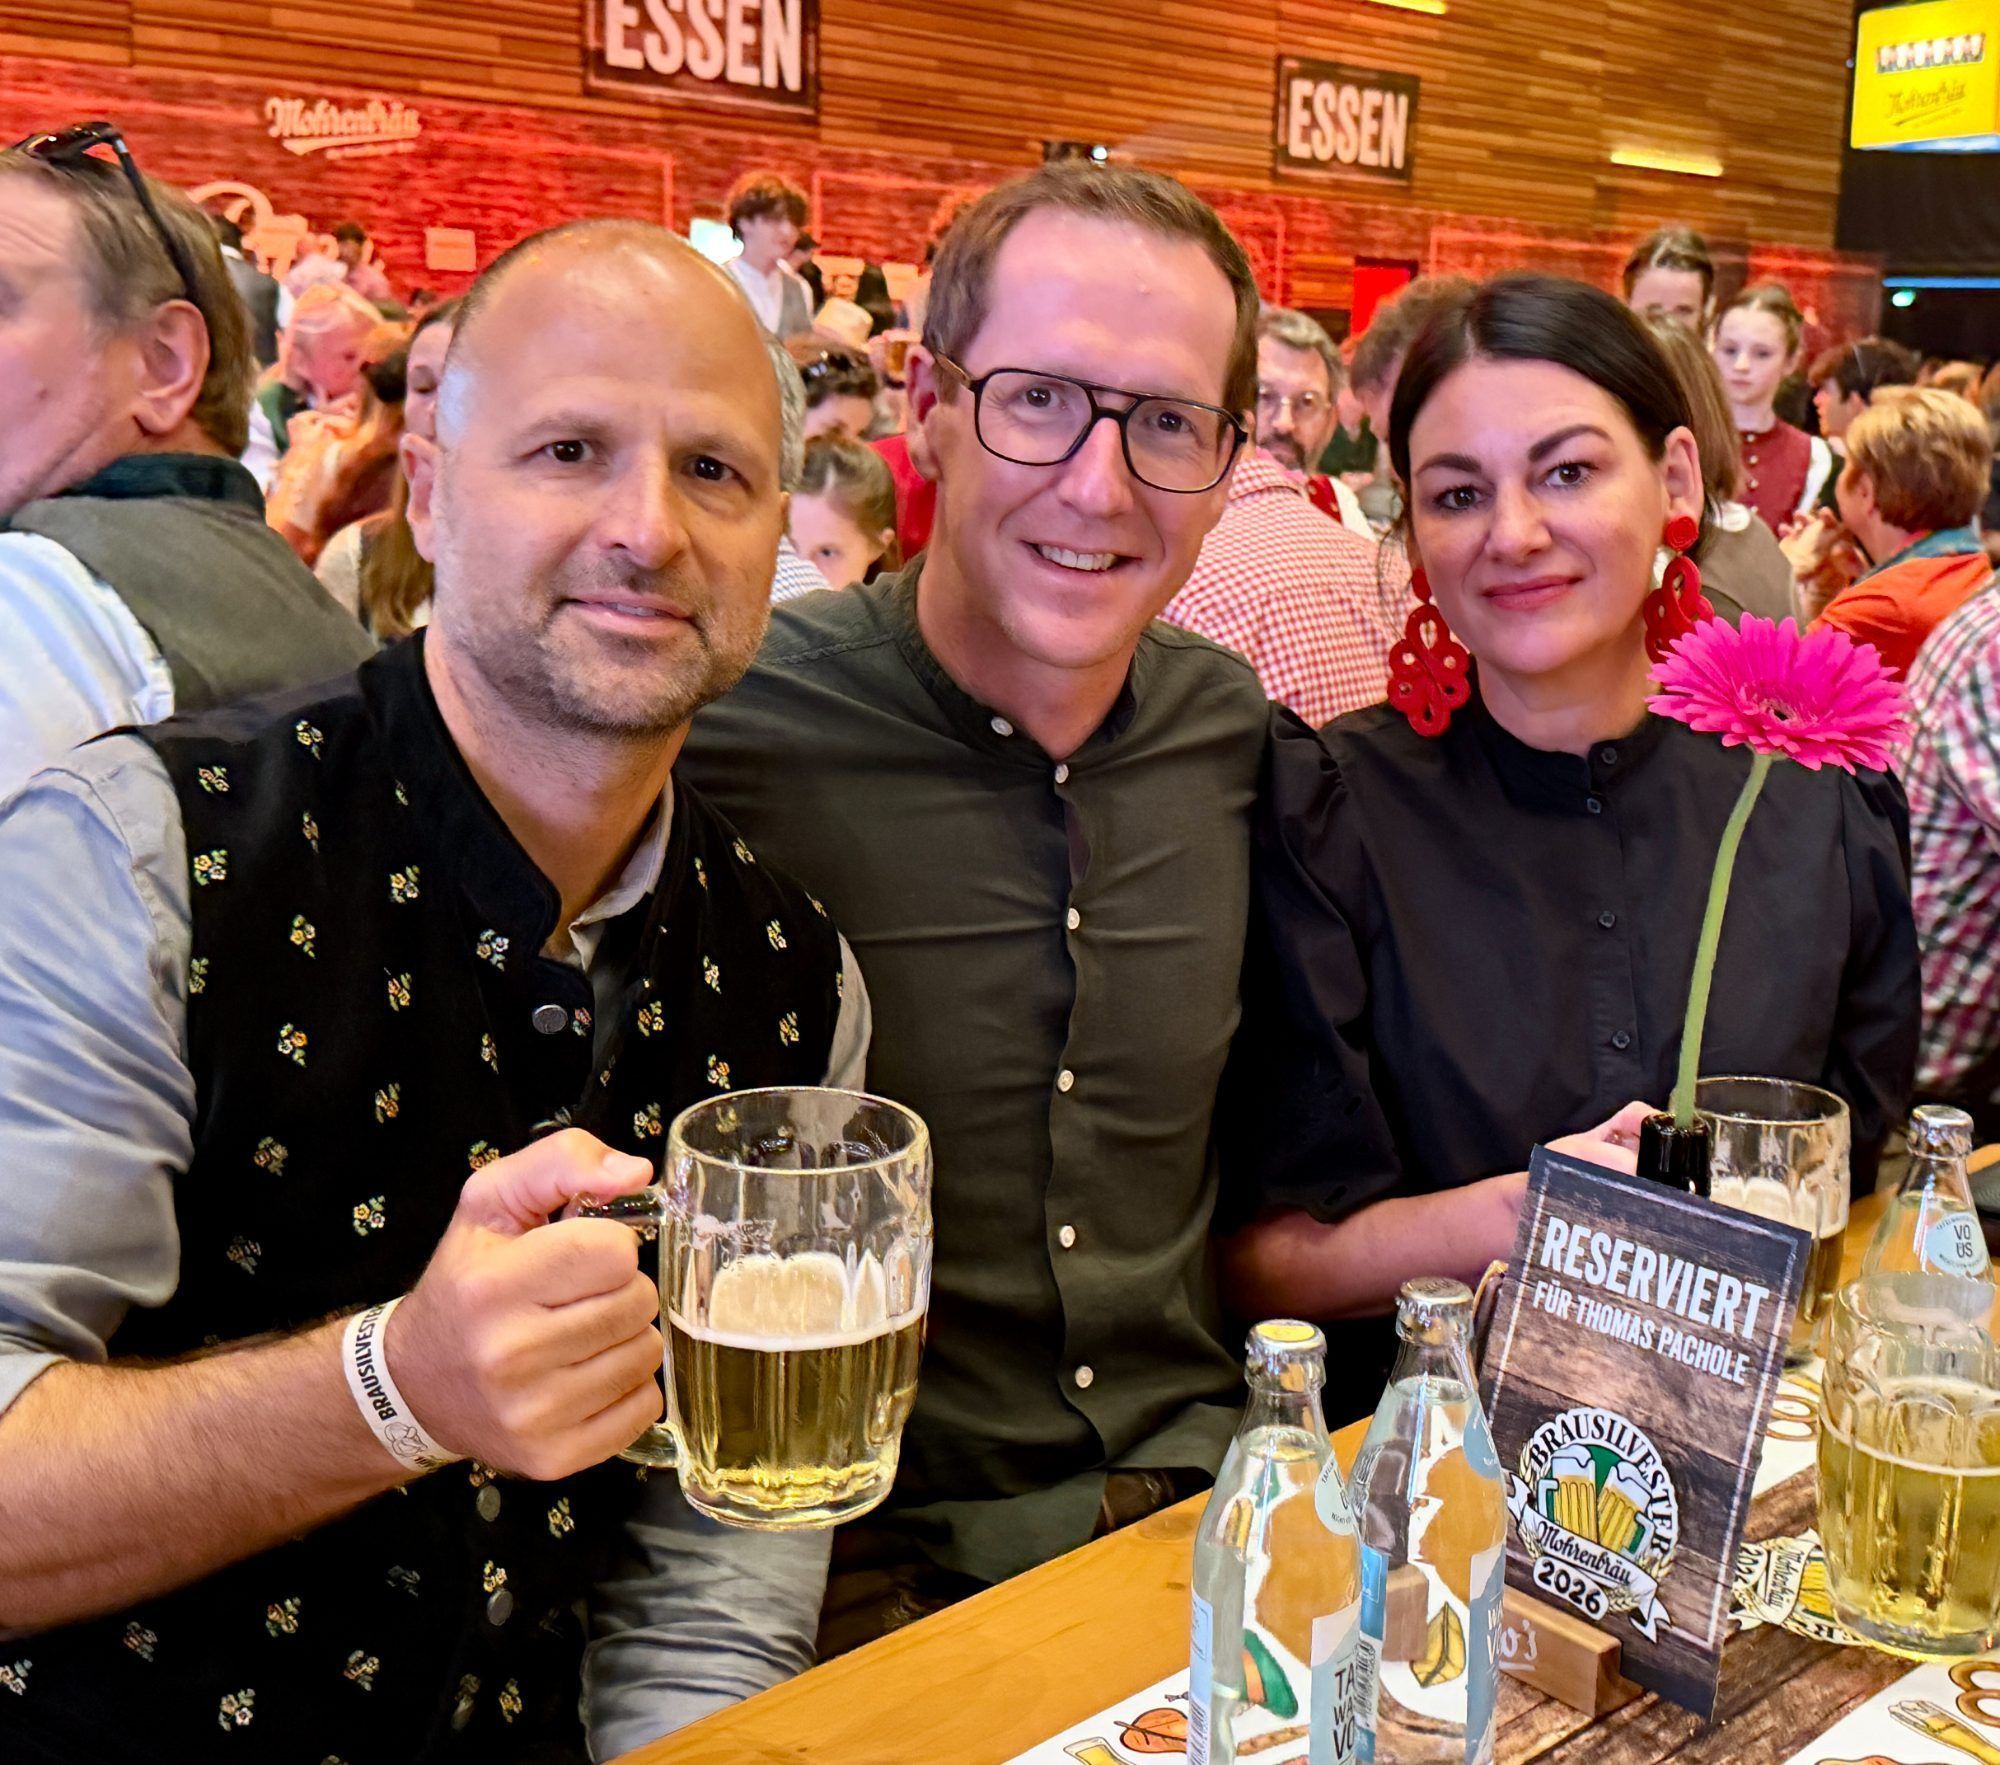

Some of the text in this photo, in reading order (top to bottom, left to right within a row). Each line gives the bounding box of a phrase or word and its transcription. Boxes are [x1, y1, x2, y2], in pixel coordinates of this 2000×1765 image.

[605, 0, 801, 92] ESSEN
[1288, 78, 1408, 169] ESSEN
[1540, 1216, 1769, 1339] RESERVIERT
[1954, 1224, 1971, 1240] VO
[1533, 1279, 1750, 1386] FÜR THOMAS PACHOLE
[1530, 1413, 1673, 1557] BRAUSILVESTER
[1536, 1520, 1631, 1586] Mohrenbräu
[1537, 1560, 1602, 1616] 2026
